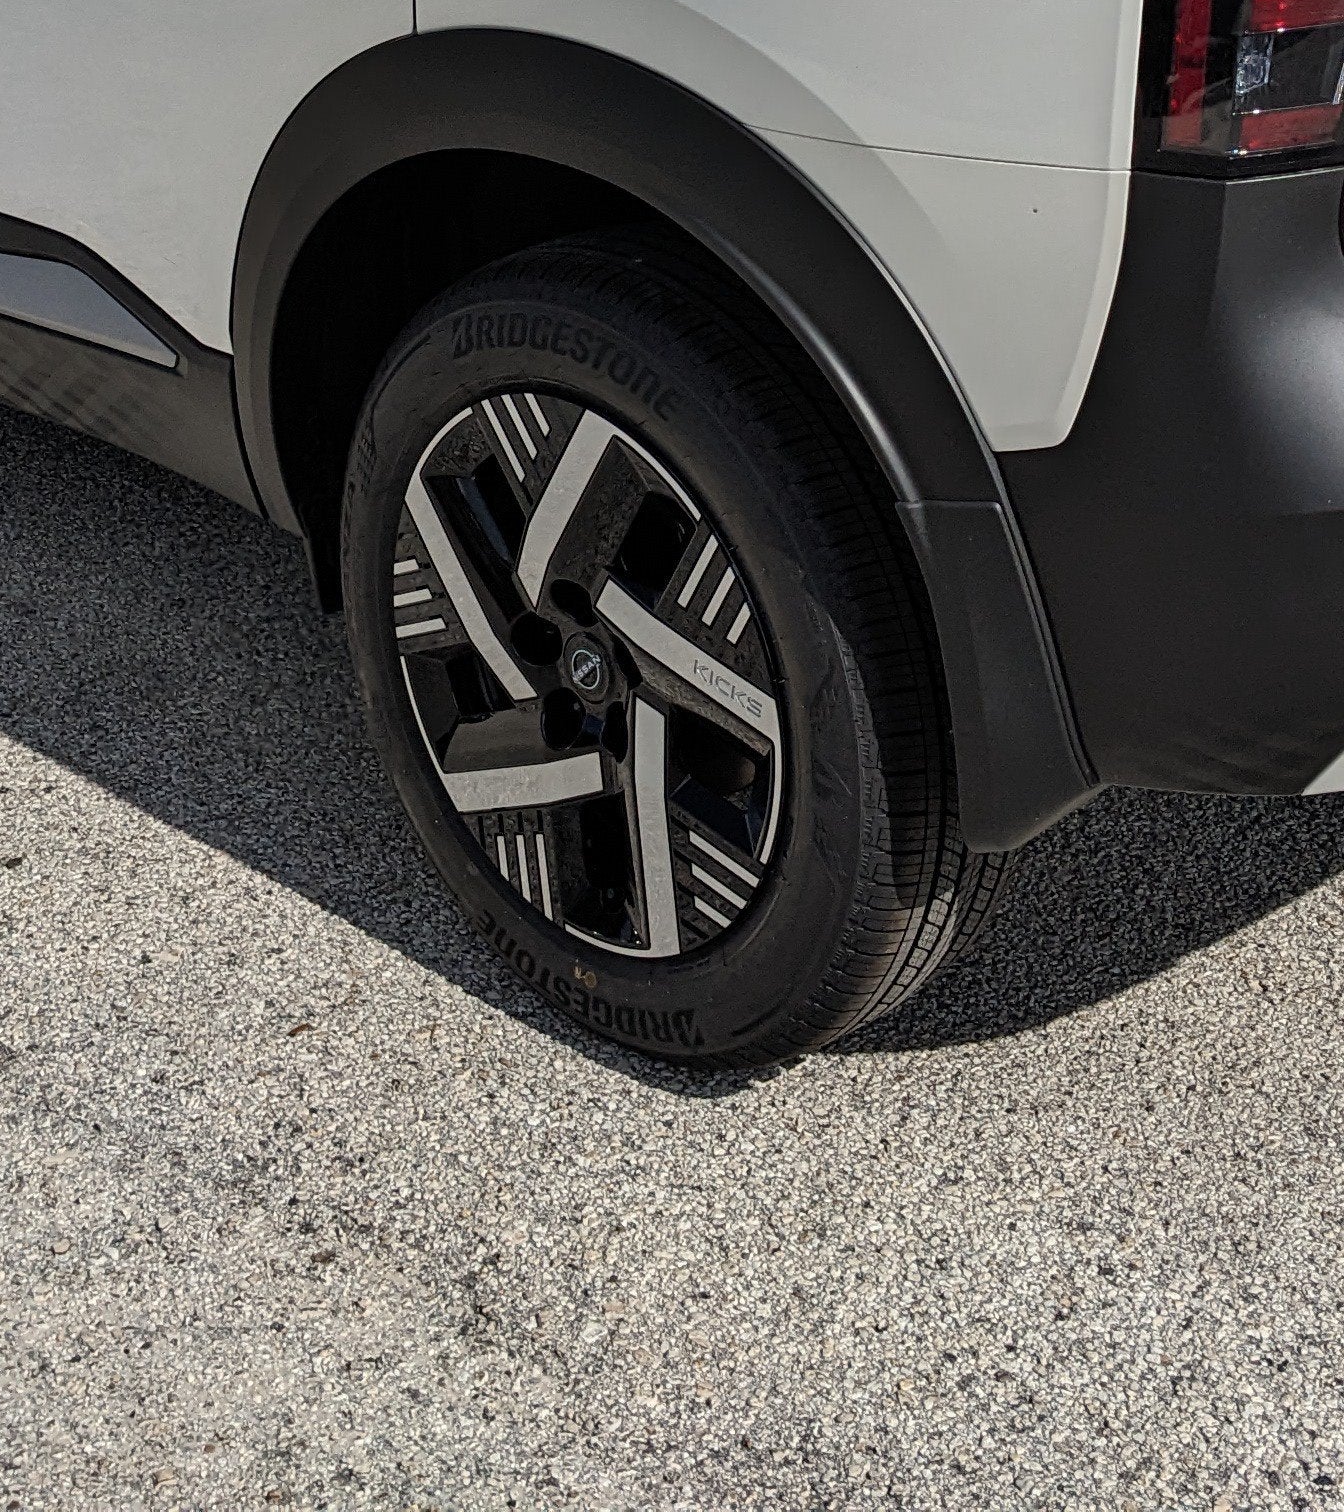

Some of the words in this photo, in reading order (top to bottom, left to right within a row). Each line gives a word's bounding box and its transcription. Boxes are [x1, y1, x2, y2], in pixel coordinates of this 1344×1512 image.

[452, 312, 685, 422] BRIDGESTONE
[572, 654, 602, 684] SSAN
[693, 659, 763, 718] KICKS
[477, 908, 706, 1048] BRIDGESTONE
